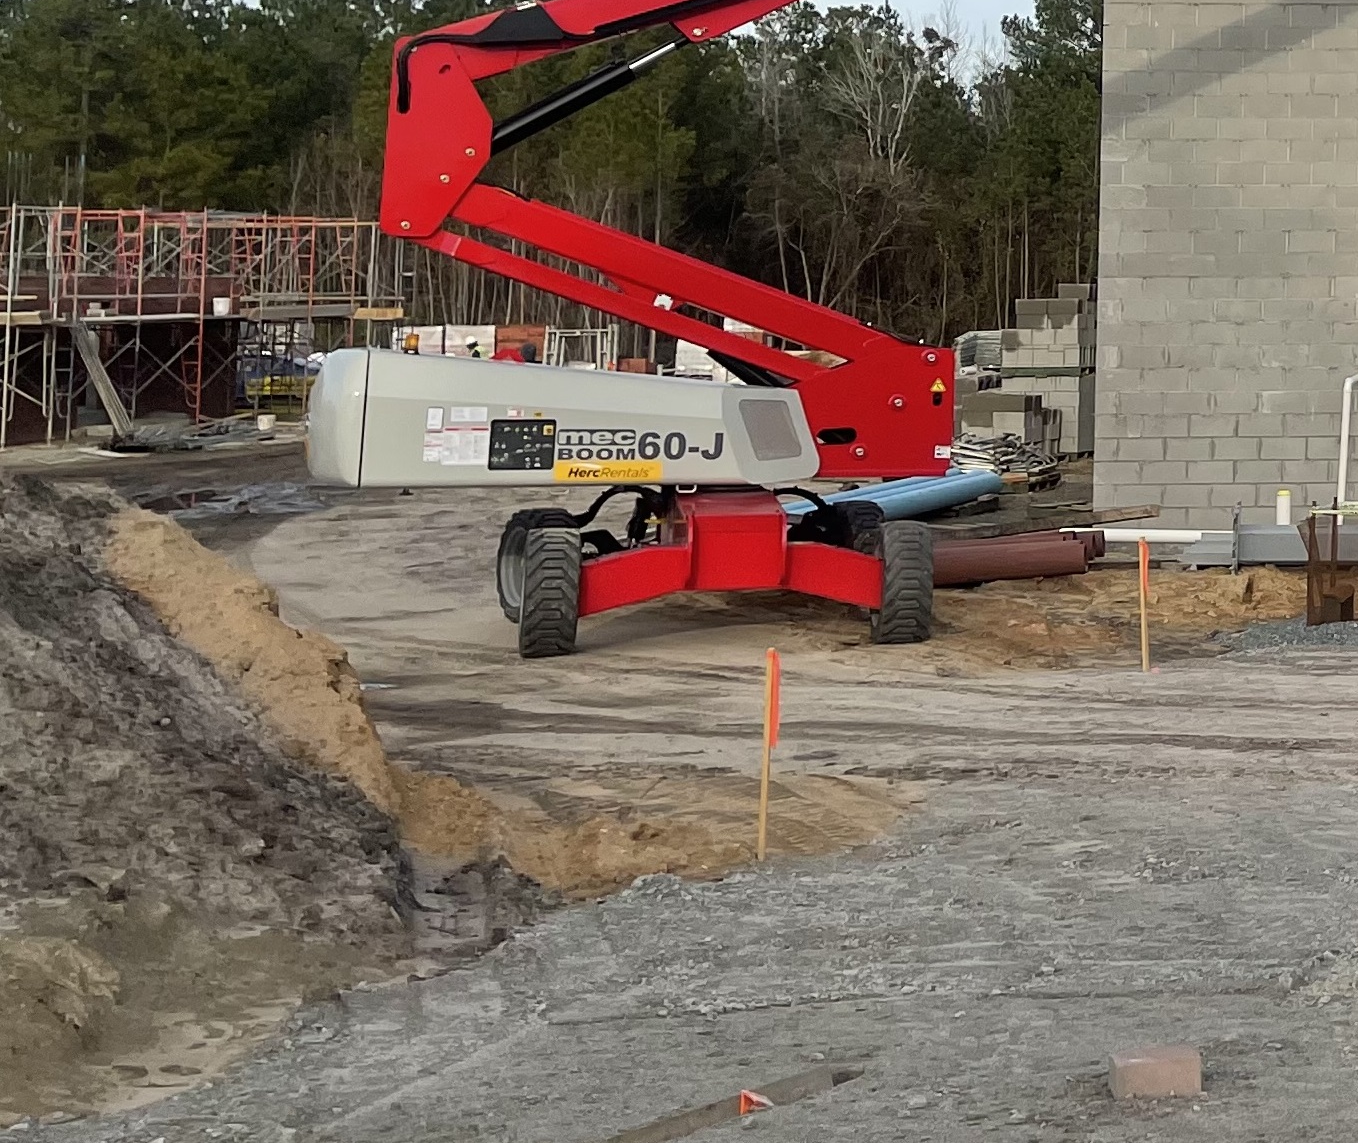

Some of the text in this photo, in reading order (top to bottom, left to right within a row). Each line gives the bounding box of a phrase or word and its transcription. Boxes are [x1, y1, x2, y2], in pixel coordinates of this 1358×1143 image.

[558, 430, 636, 446] mec
[557, 432, 724, 461] BOOM 60-J
[567, 467, 650, 479] HercRentals
